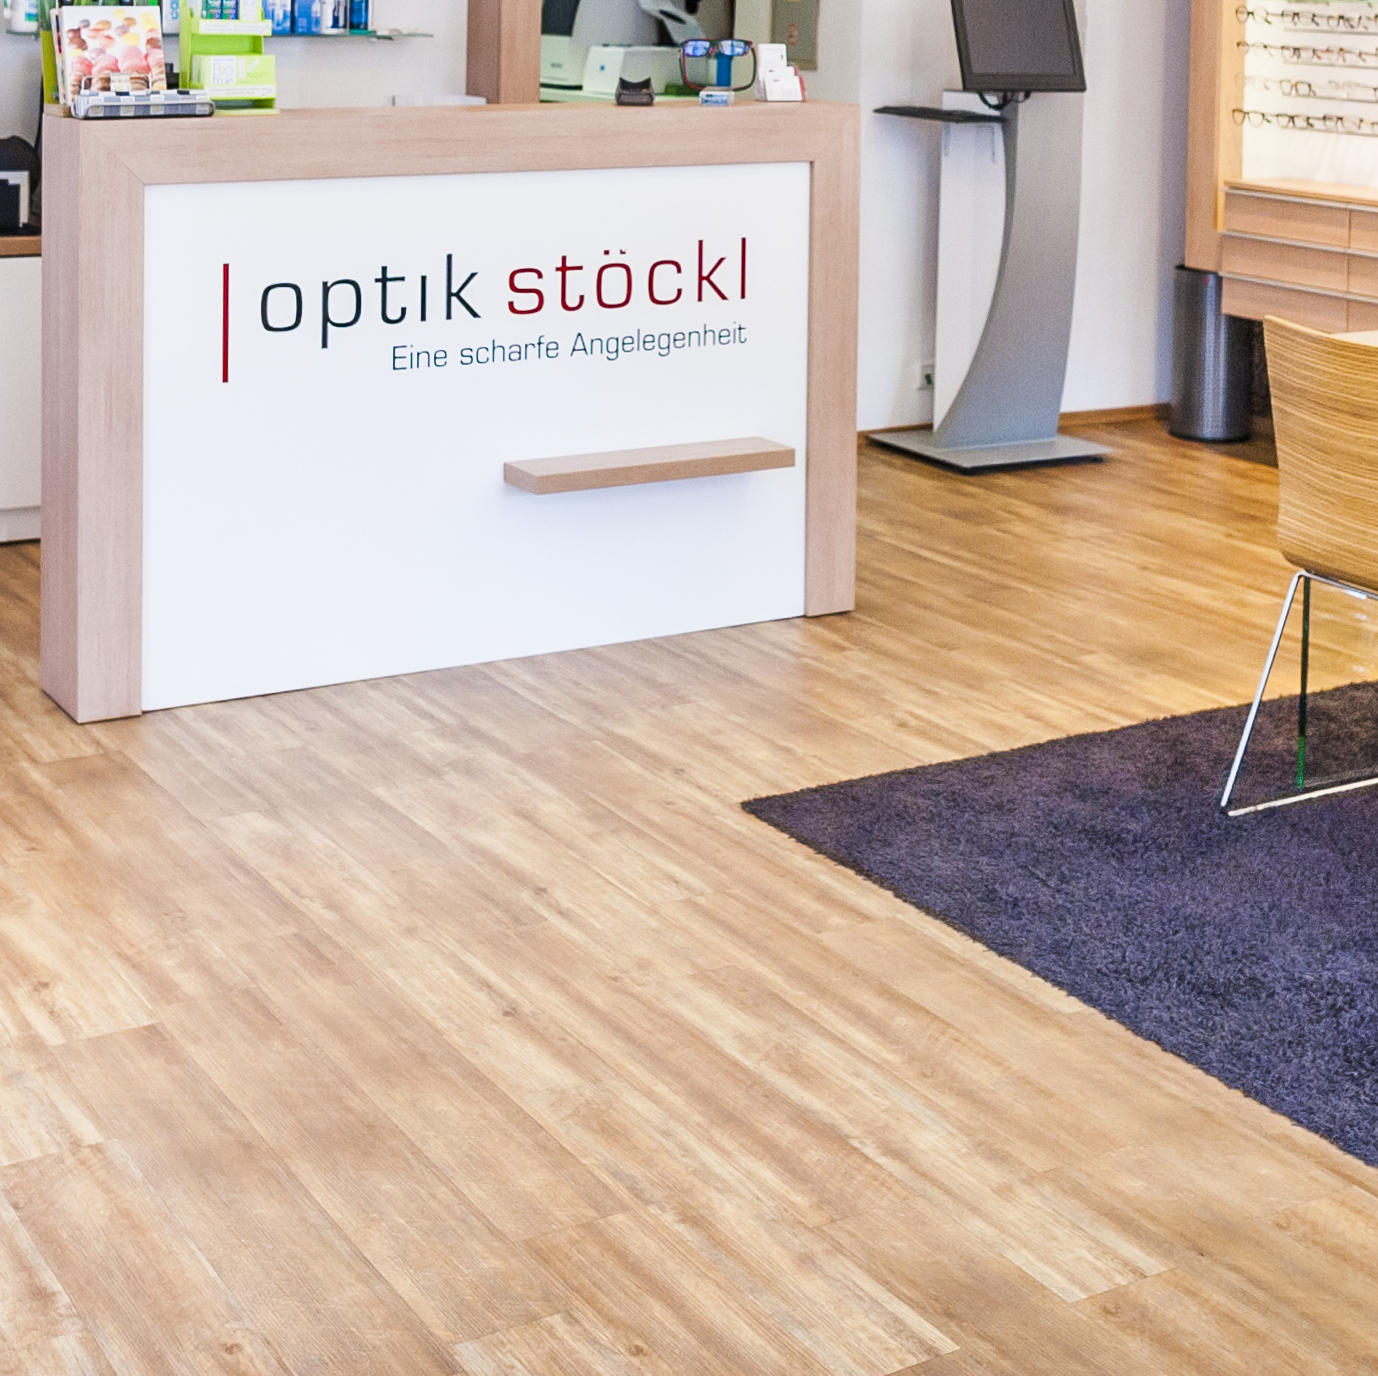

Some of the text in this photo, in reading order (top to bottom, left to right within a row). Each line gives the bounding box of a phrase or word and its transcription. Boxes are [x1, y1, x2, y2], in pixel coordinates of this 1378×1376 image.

[260, 236, 748, 350] optik stöckl
[392, 322, 748, 371] Eine scharfe Angelegenheit
